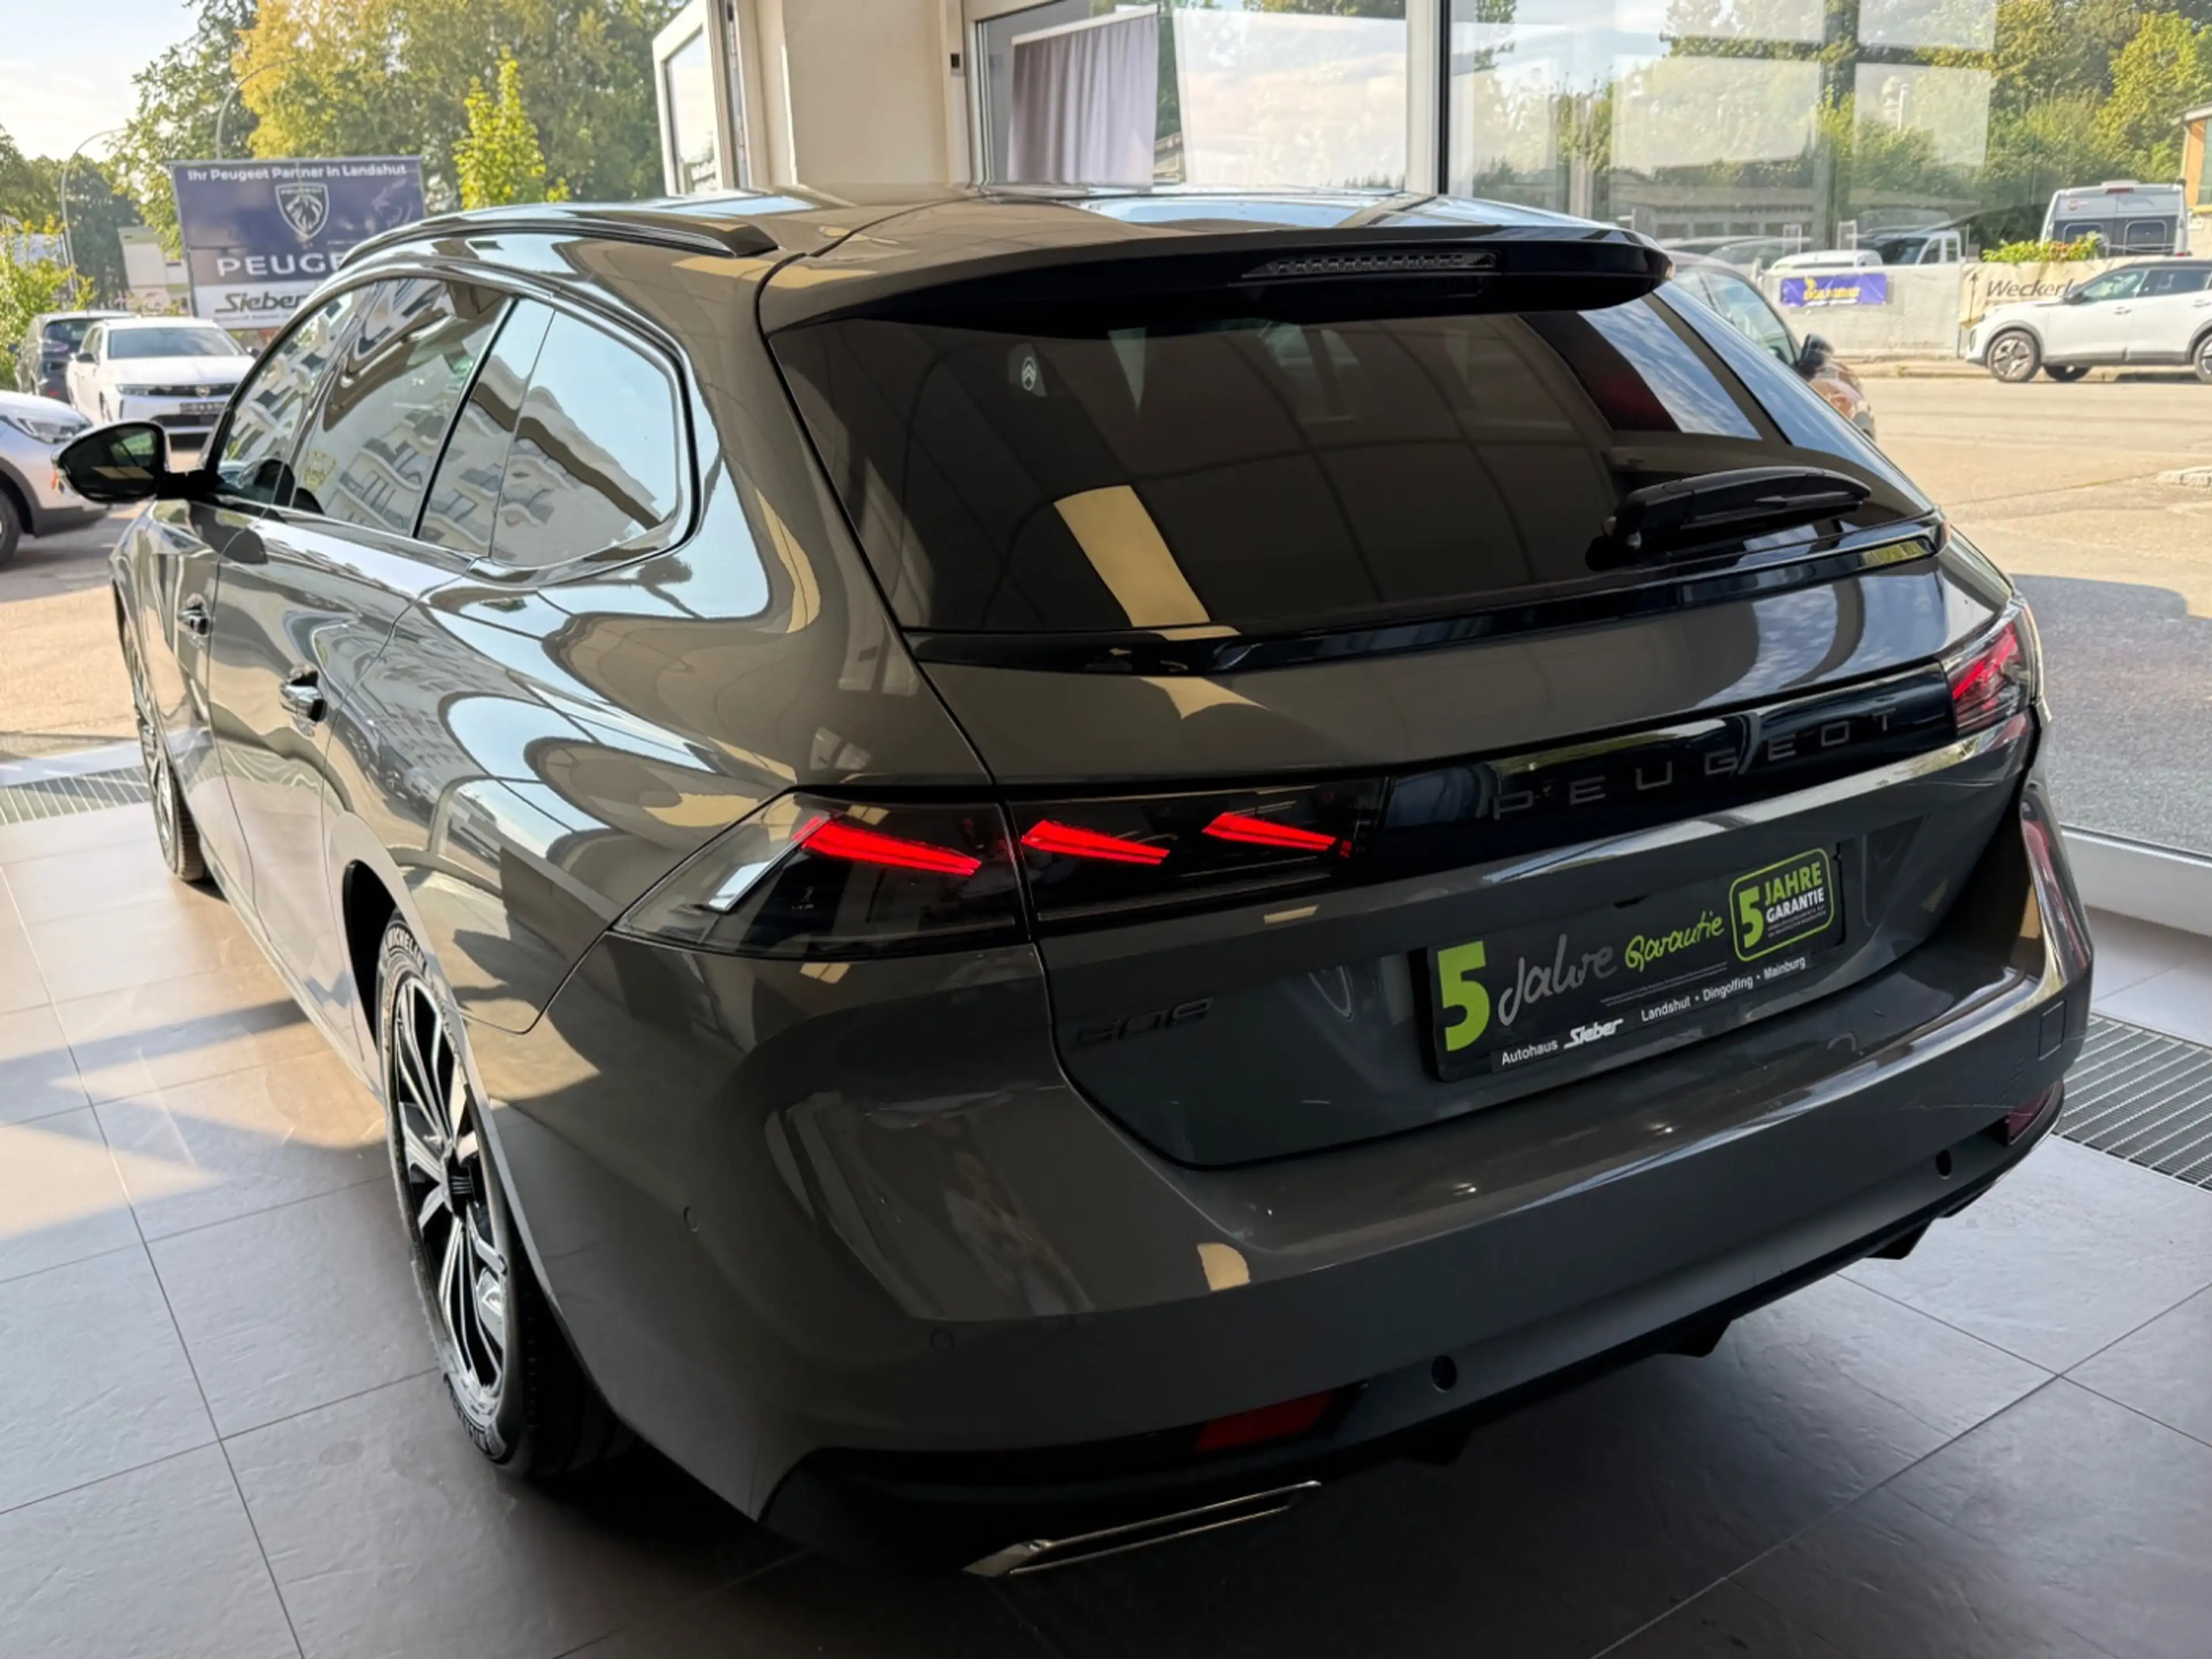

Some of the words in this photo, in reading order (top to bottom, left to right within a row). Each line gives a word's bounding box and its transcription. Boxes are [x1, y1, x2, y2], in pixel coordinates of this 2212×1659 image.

[187, 169, 207, 181] Ihr
[210, 168, 269, 181] Peugeot
[272, 166, 323, 180] Partner
[342, 164, 407, 177] Landshut
[1493, 708, 1897, 820] PEUGEOT
[1738, 885, 1764, 949] 5
[1764, 862, 1822, 906] JAHRE
[1766, 888, 1824, 923] GARANTIE
[1438, 941, 1490, 1051] 5
[1498, 934, 1618, 1027] Jahre
[1625, 910, 1725, 972] Garantie
[1502, 1040, 1558, 1065] Autohaus
[1564, 1018, 1624, 1049] Sieber
[1641, 997, 1691, 1022] Landshut
[1703, 976, 1753, 1001] Dingolfing
[1763, 957, 1805, 980] Mainburg
